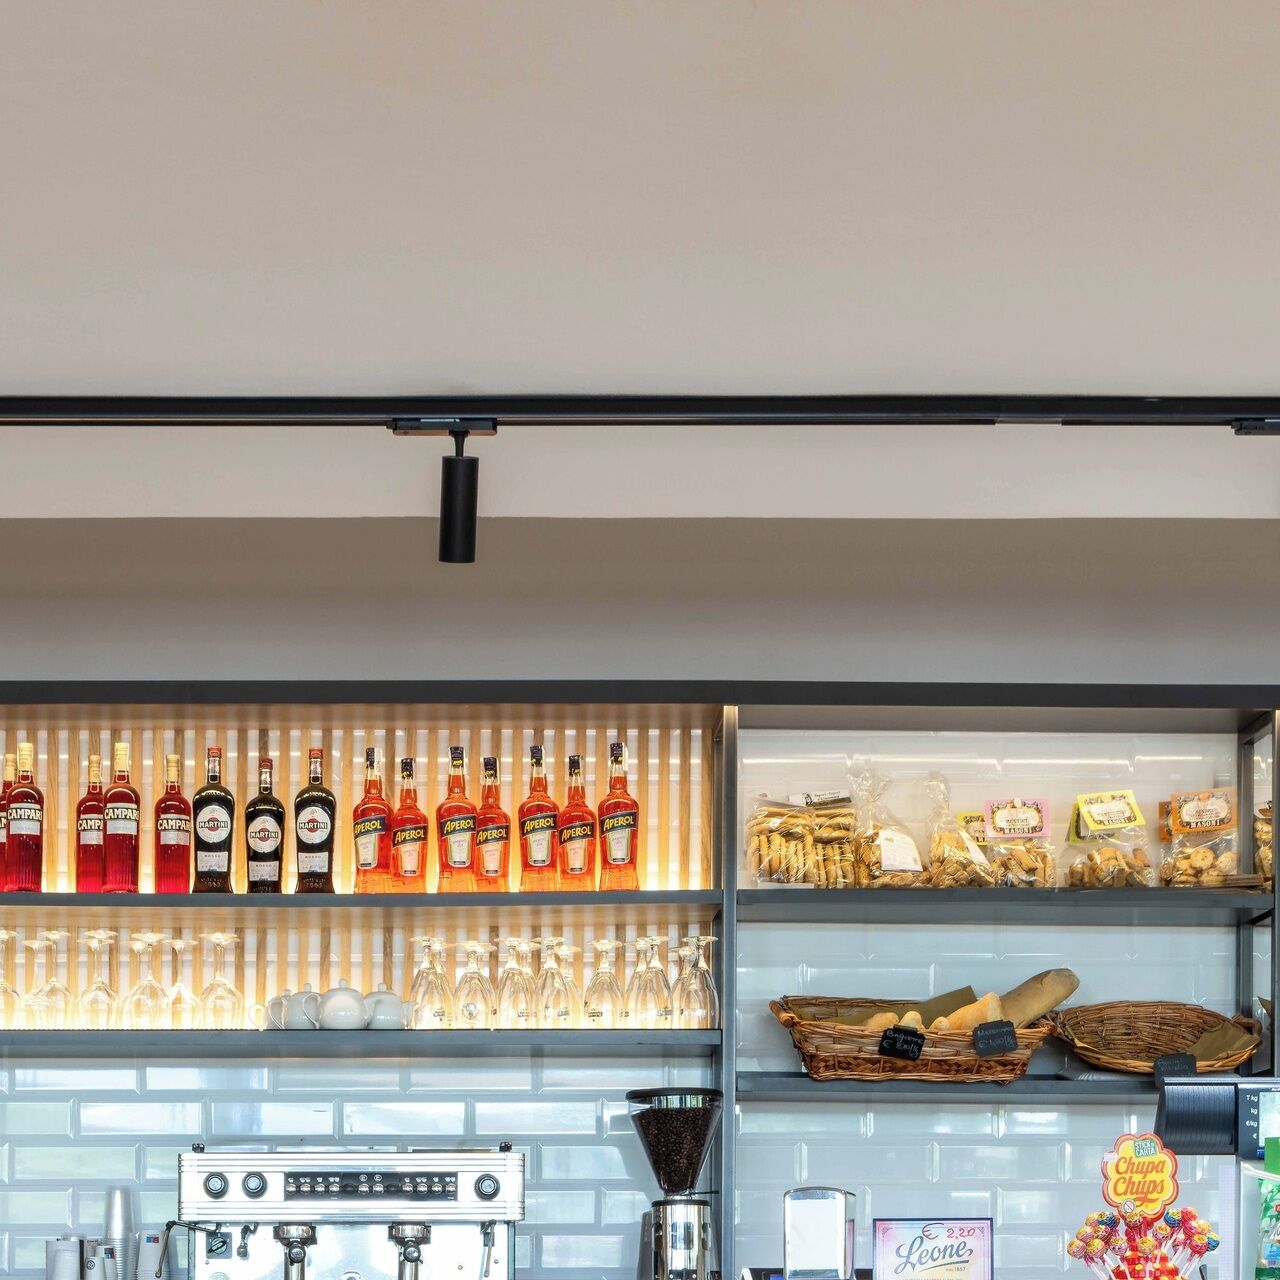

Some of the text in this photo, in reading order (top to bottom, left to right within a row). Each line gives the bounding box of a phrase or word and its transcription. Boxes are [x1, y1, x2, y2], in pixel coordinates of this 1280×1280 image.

[7, 808, 43, 820] CAMPARI
[444, 820, 475, 833] APEROL
[524, 818, 555, 833] APEROL
[603, 815, 634, 831] APEROL
[1191, 819, 1221, 828] MASONI
[394, 829, 425, 843] APEROL
[476, 828, 507, 843] APEROL
[561, 827, 592, 842] APEROL
[1115, 1156, 1167, 1179] Chupa
[1113, 1175, 1165, 1199] Chups
[922, 1222, 976, 1240] € 2,20
[894, 1235, 974, 1275] Leone
